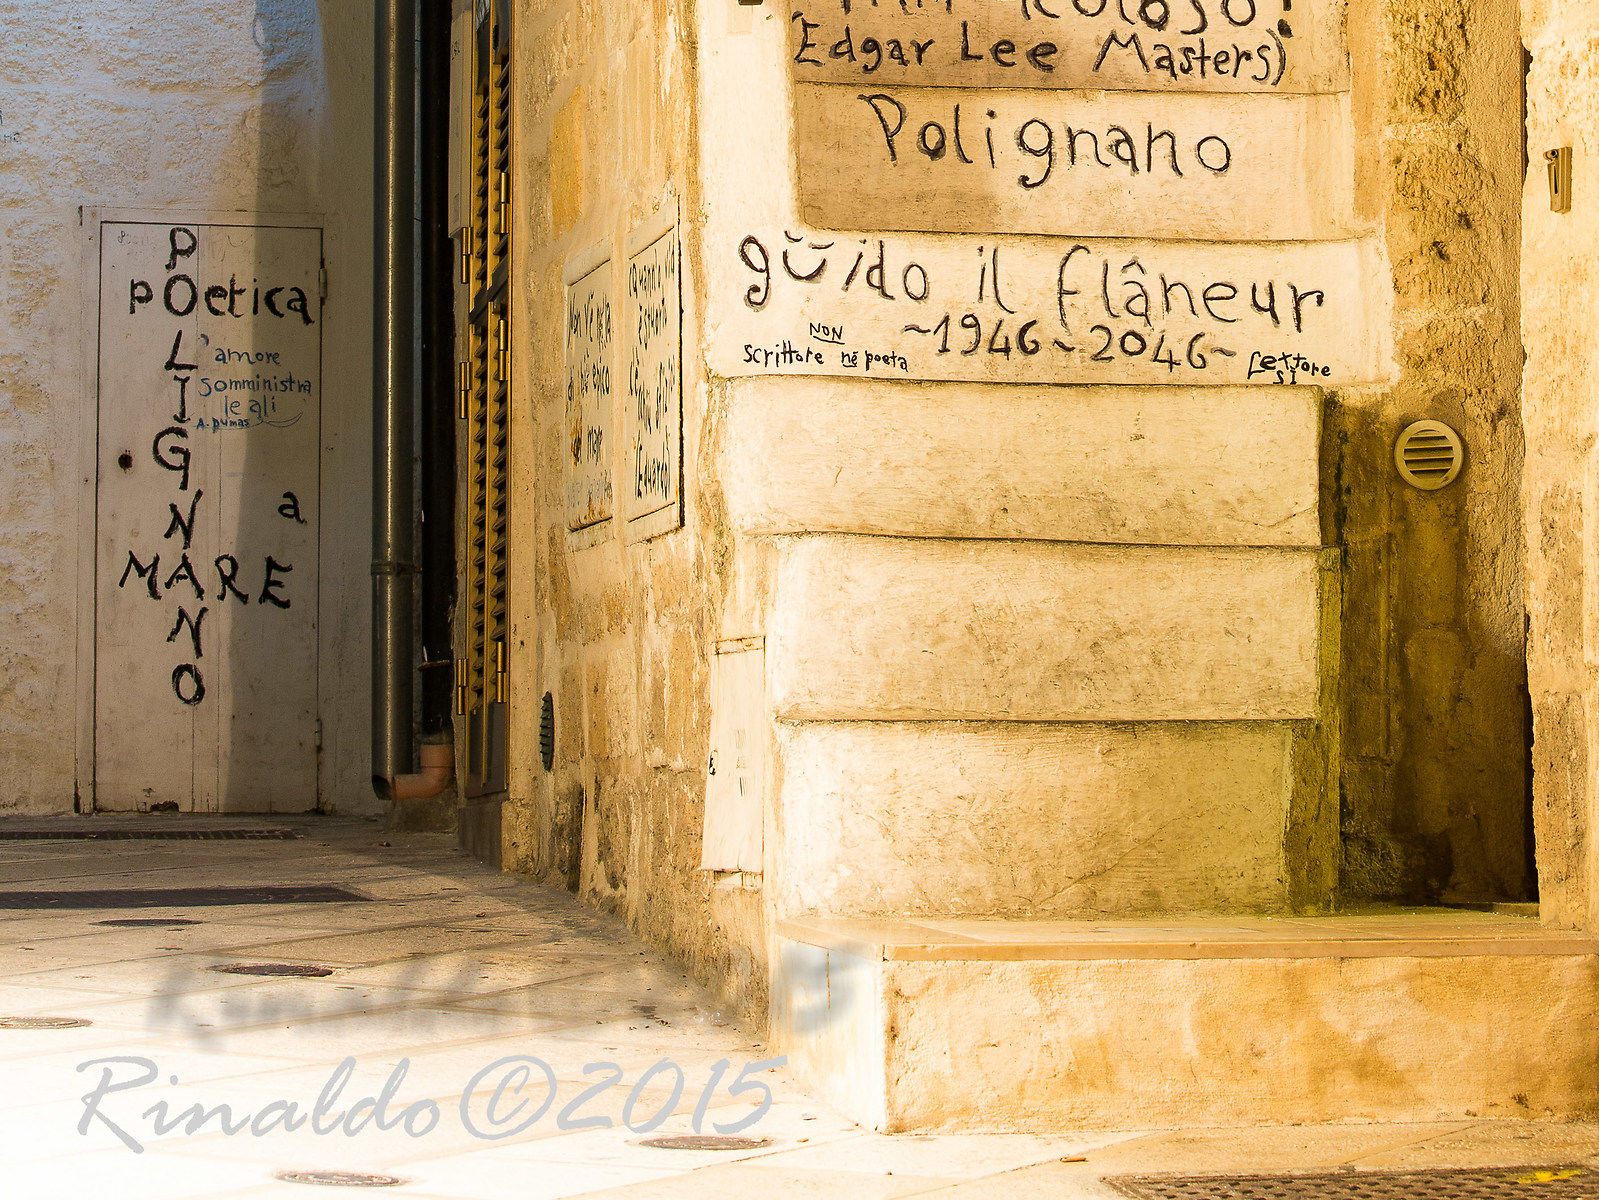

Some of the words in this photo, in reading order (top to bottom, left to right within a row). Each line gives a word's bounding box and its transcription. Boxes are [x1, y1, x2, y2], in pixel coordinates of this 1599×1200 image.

[960, 20, 1058, 70] Lee
[1093, 29, 1287, 85] Masters)
[857, 94, 1232, 189] Polignano
[976, 245, 1016, 314] il
[810, 322, 845, 344] NON
[865, 350, 909, 373] poeta
[1247, 351, 1331, 379] Lettore
[225, 395, 240, 417] le
[248, 394, 276, 420] ali
[149, 226, 206, 706] POLIGNANO
[277, 490, 307, 524] a
[119, 550, 294, 609] MARE
